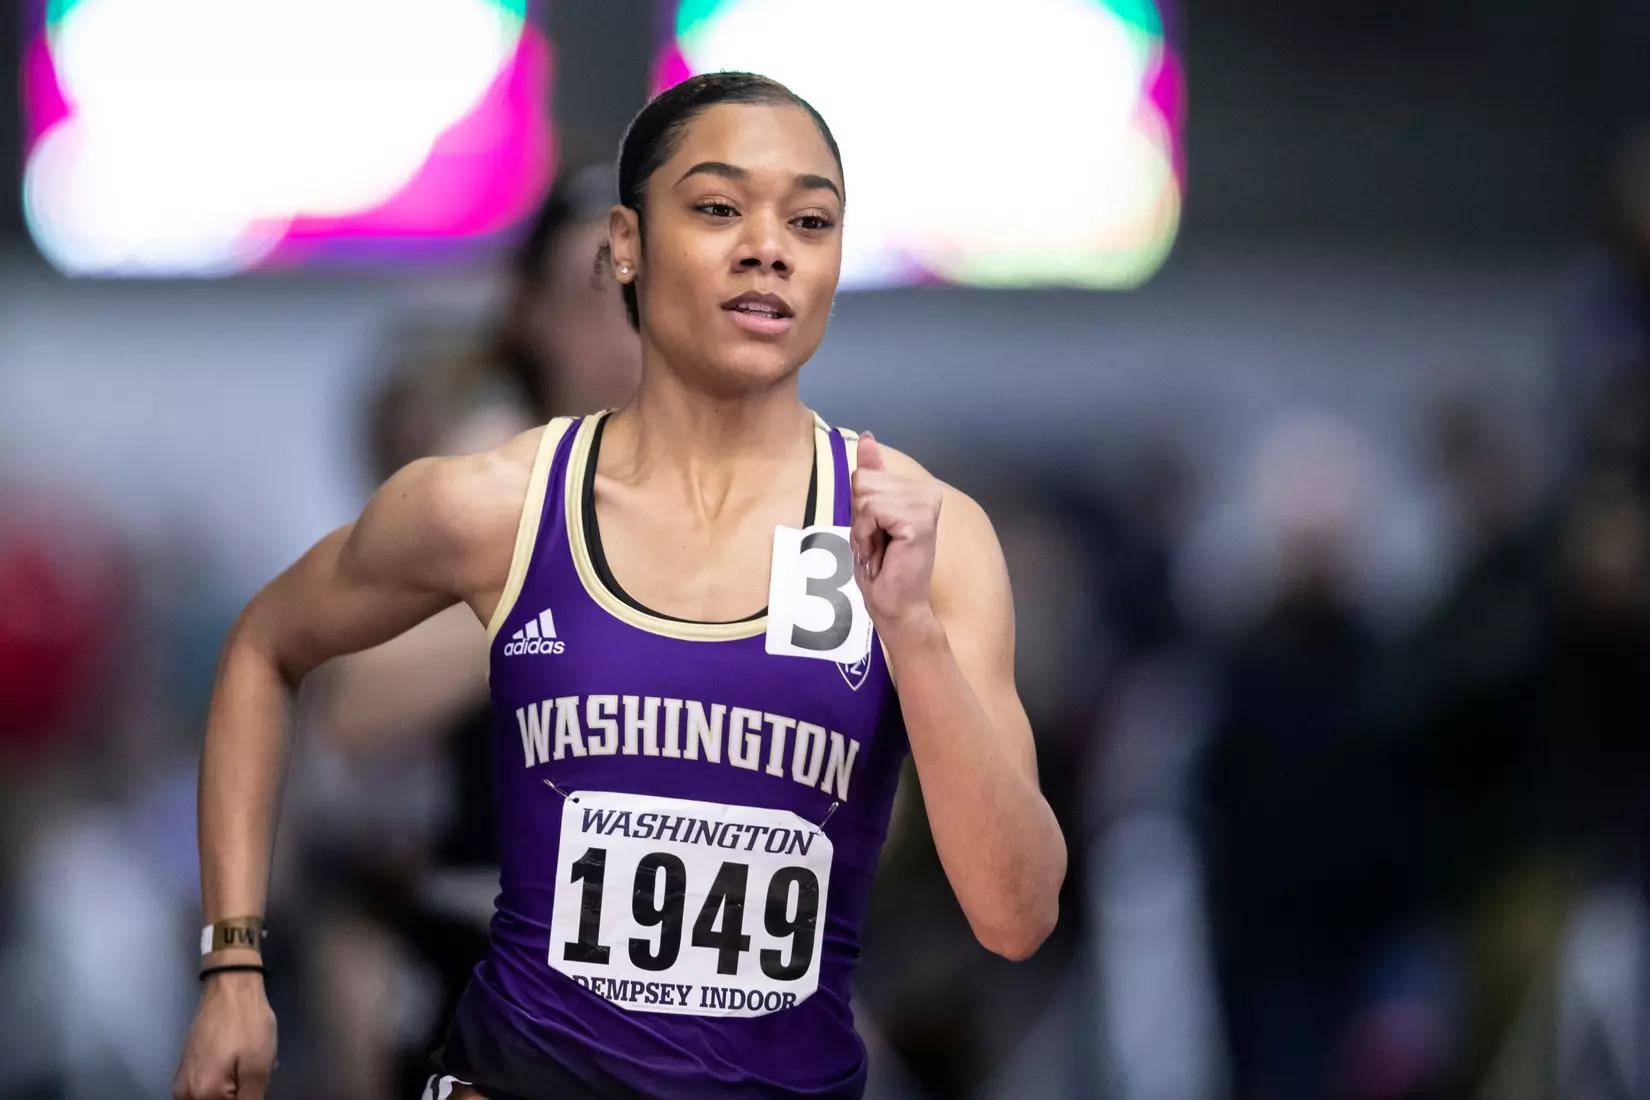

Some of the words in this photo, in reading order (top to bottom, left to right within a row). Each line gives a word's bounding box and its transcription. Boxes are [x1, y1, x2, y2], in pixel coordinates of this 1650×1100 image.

[790, 532, 853, 651] 3
[504, 637, 565, 656] adidas
[516, 695, 860, 802] WASHINGTON
[581, 808, 816, 856] WASHINGTON
[563, 847, 819, 981] 1949
[699, 986, 797, 1011] INDOOR
